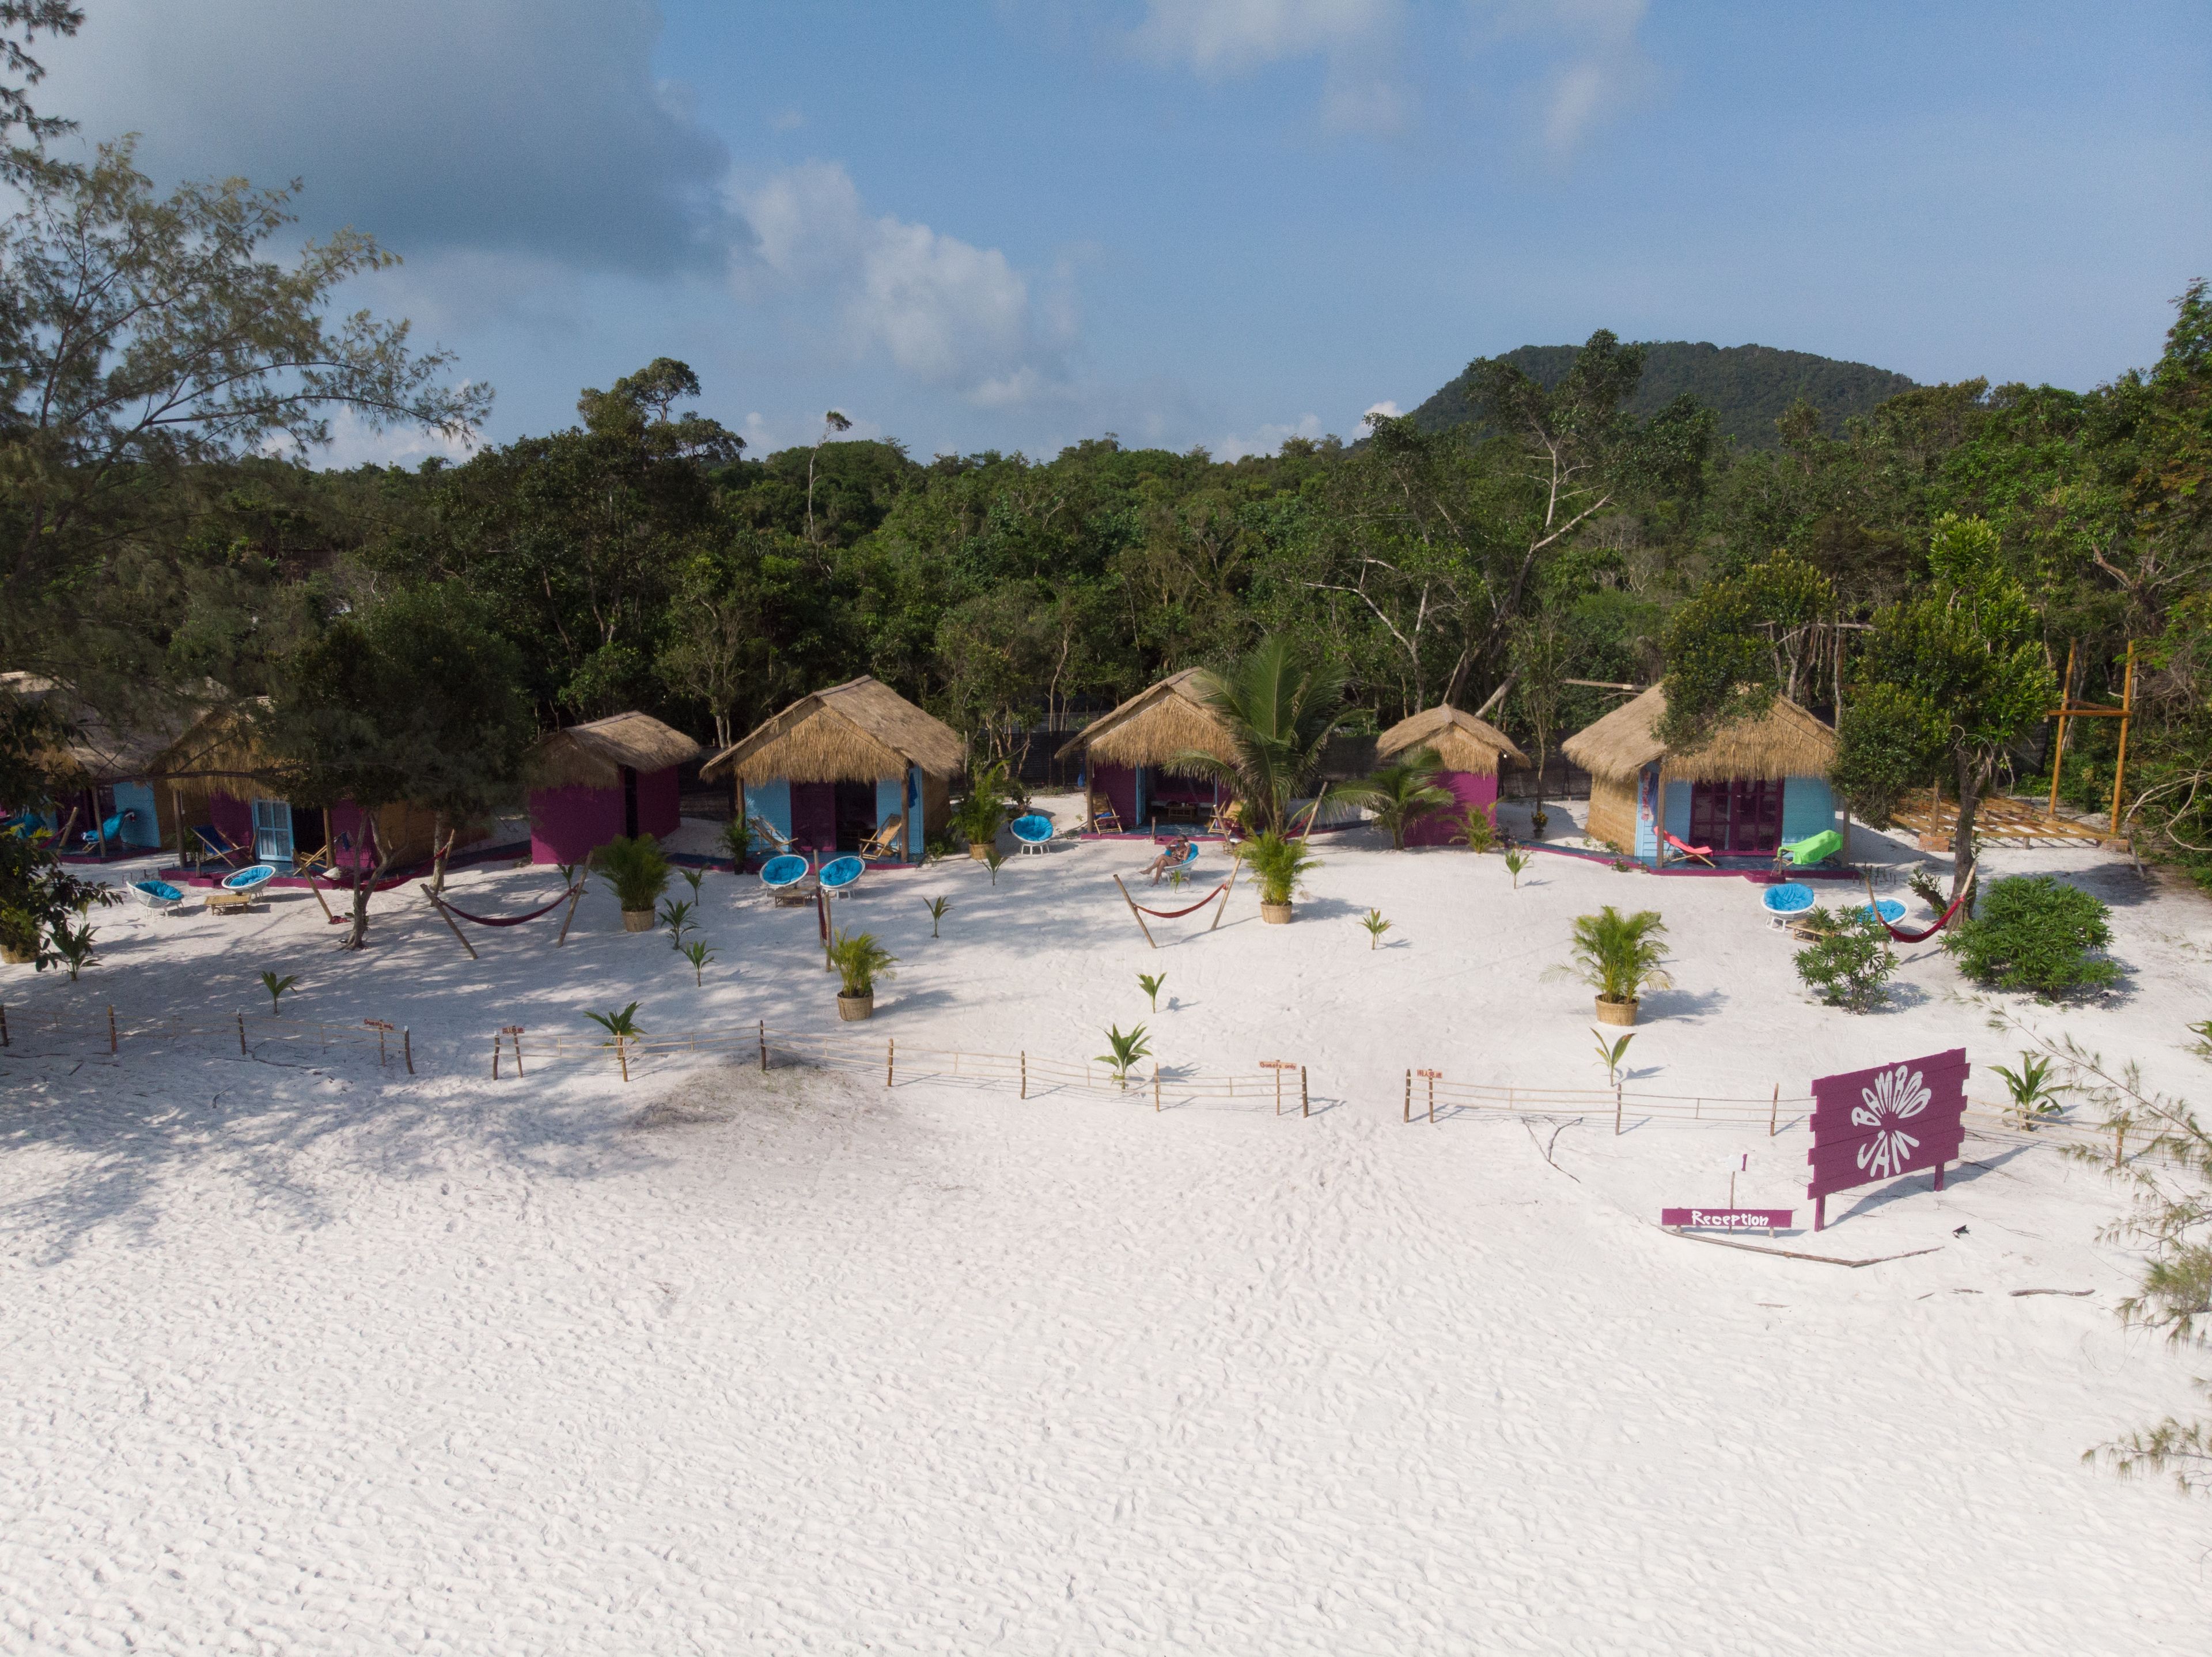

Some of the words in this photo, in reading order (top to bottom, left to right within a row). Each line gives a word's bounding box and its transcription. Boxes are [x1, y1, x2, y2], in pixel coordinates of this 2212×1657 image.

[1851, 1065, 1931, 1126] BAMBOO
[1857, 1130, 1919, 1178] JAM
[1691, 1210, 1769, 1225] Reception
